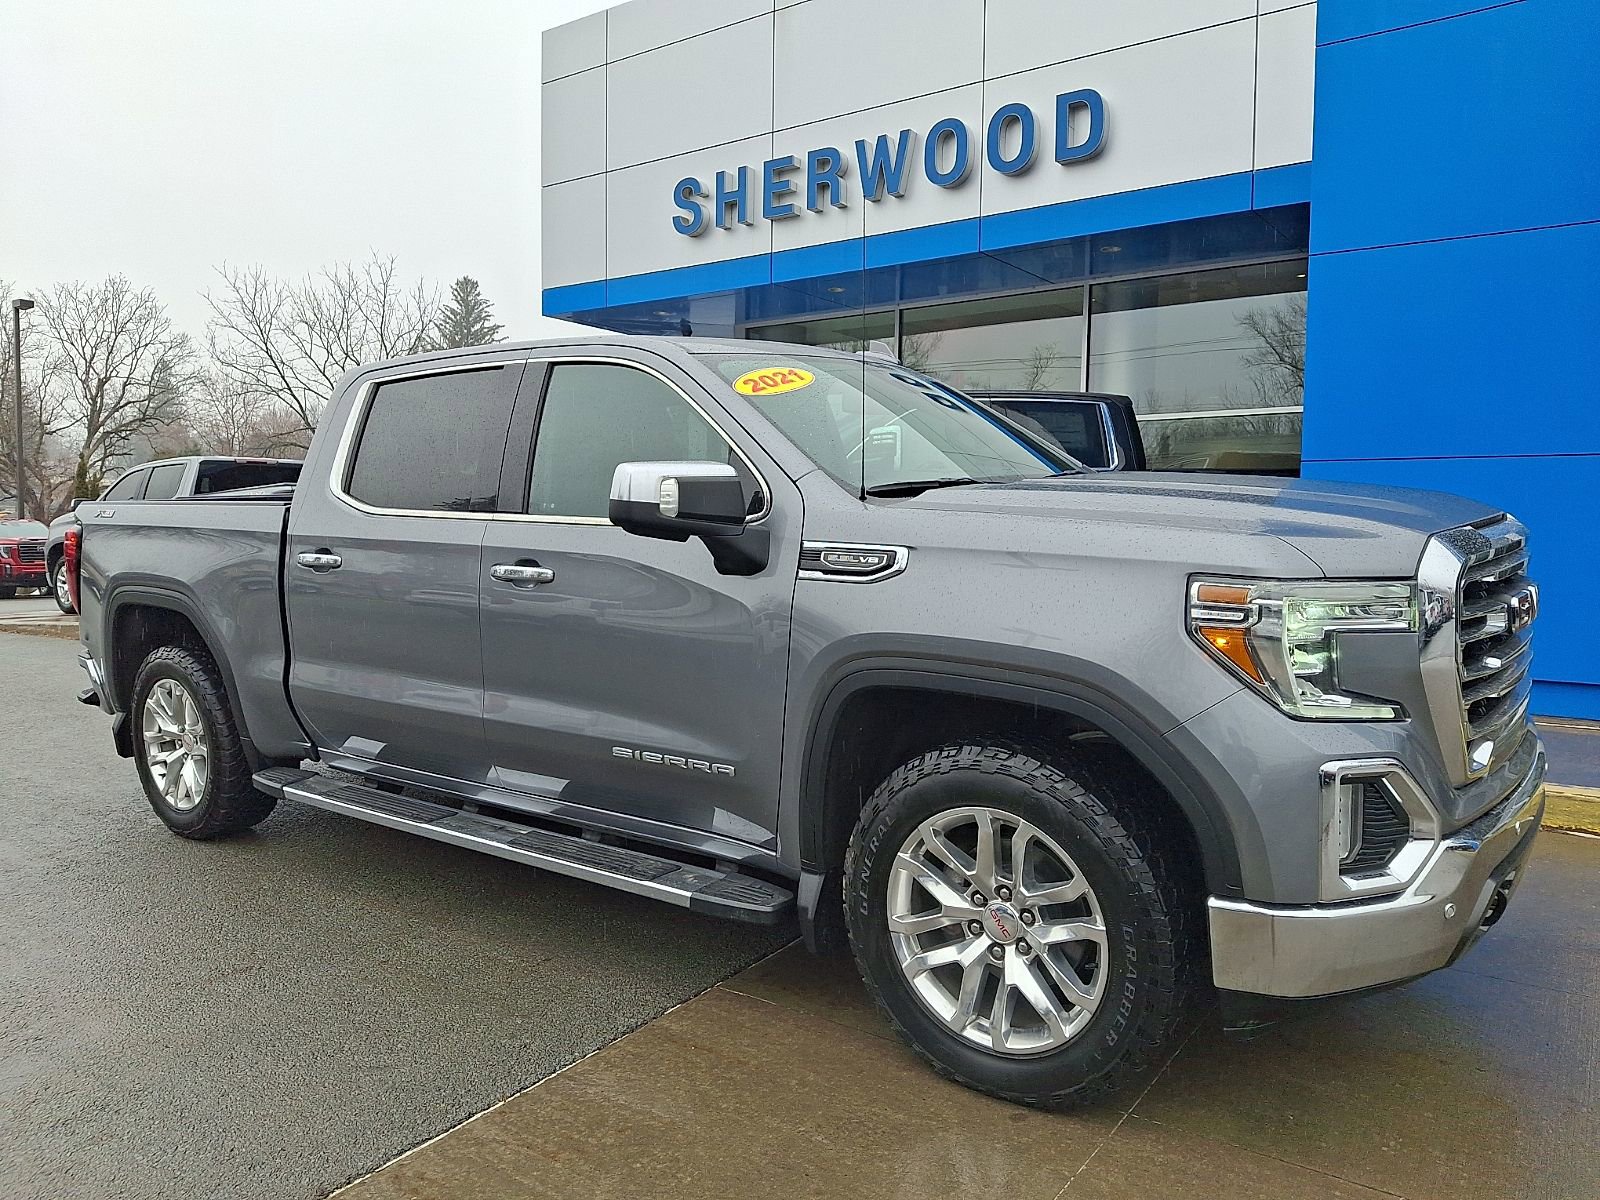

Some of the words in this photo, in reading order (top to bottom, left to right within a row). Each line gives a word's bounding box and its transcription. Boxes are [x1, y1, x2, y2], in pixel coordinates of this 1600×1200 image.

[671, 88, 1110, 237] SHERWOOD
[742, 369, 806, 393] 2021
[612, 746, 736, 777] SIERRA
[859, 815, 897, 916] GENERAL
[990, 909, 1011, 939] GMC
[1105, 925, 1137, 1046] GRABBER
